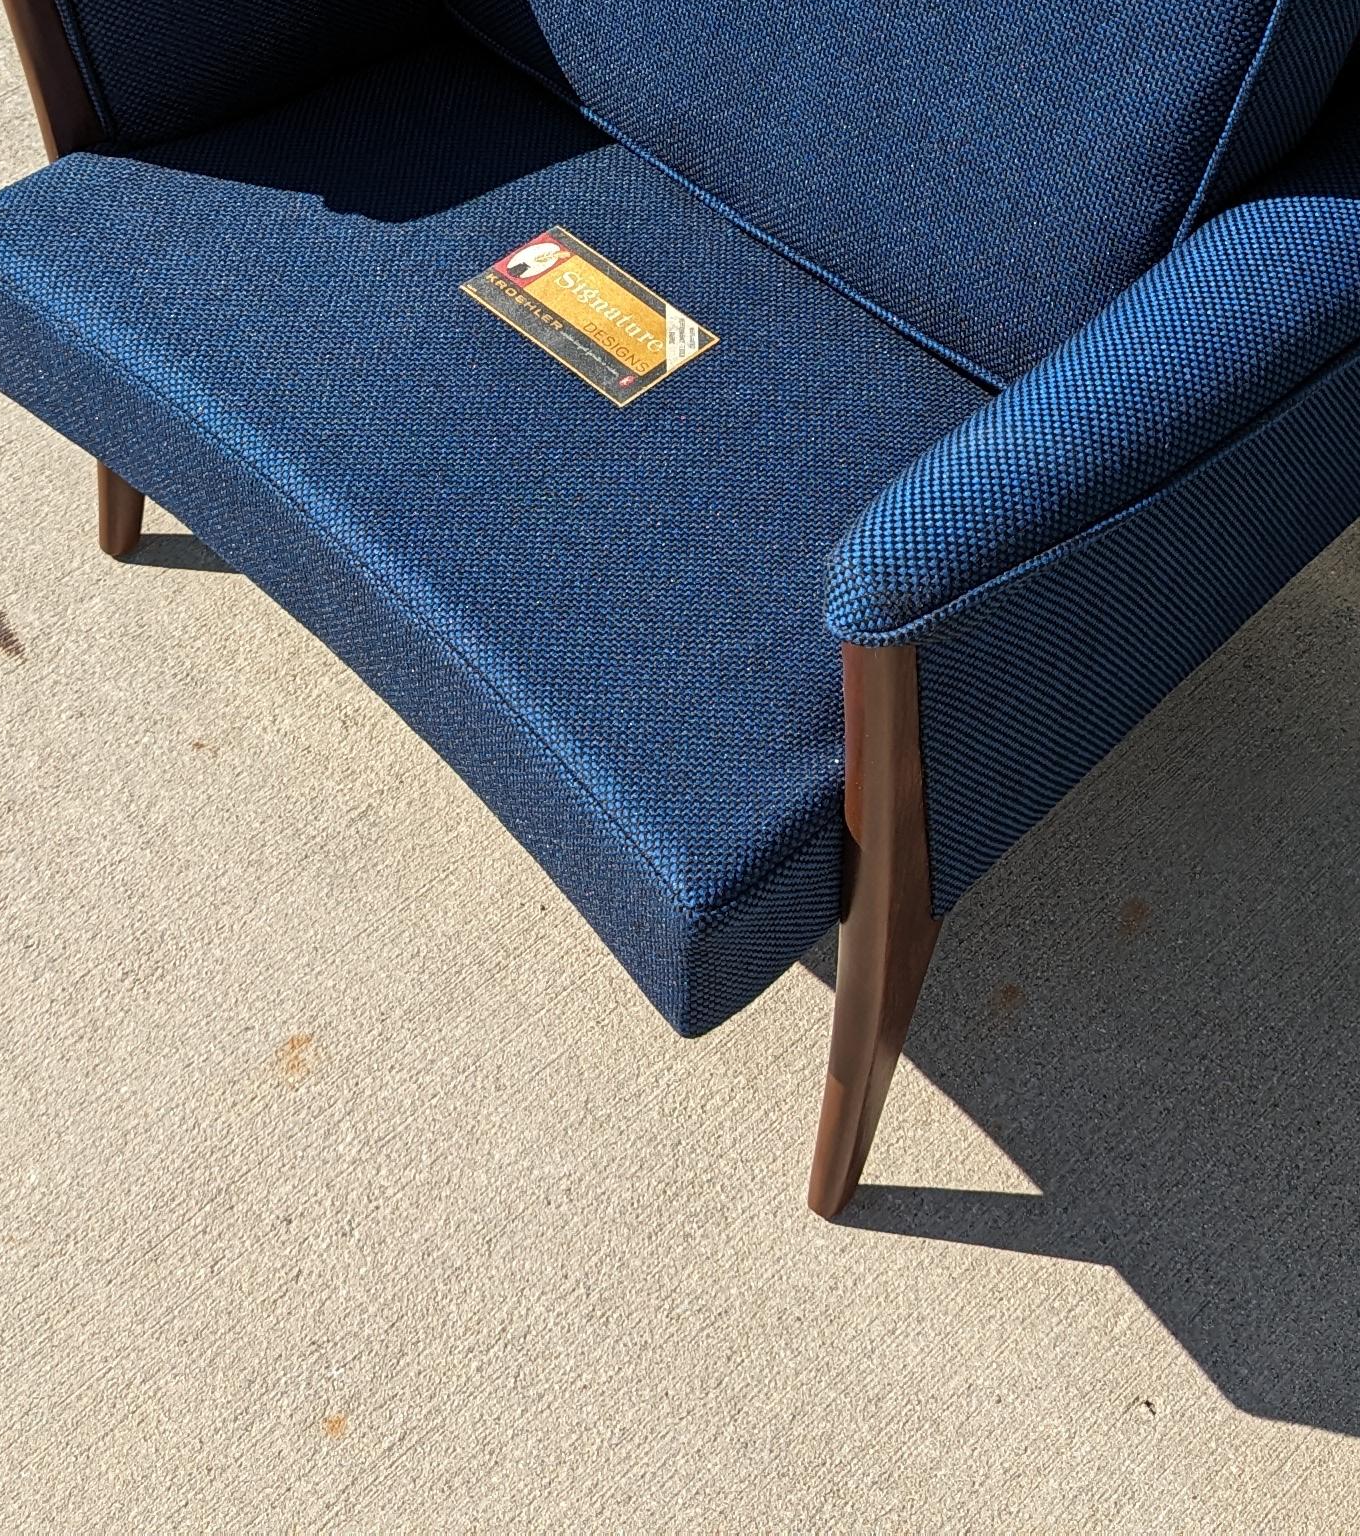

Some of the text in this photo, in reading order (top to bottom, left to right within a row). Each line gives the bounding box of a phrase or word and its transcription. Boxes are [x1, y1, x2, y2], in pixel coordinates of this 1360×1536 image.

[486, 273, 564, 331] KROEHLER
[554, 271, 663, 353] Signature
[583, 321, 649, 372] DESIGNS
